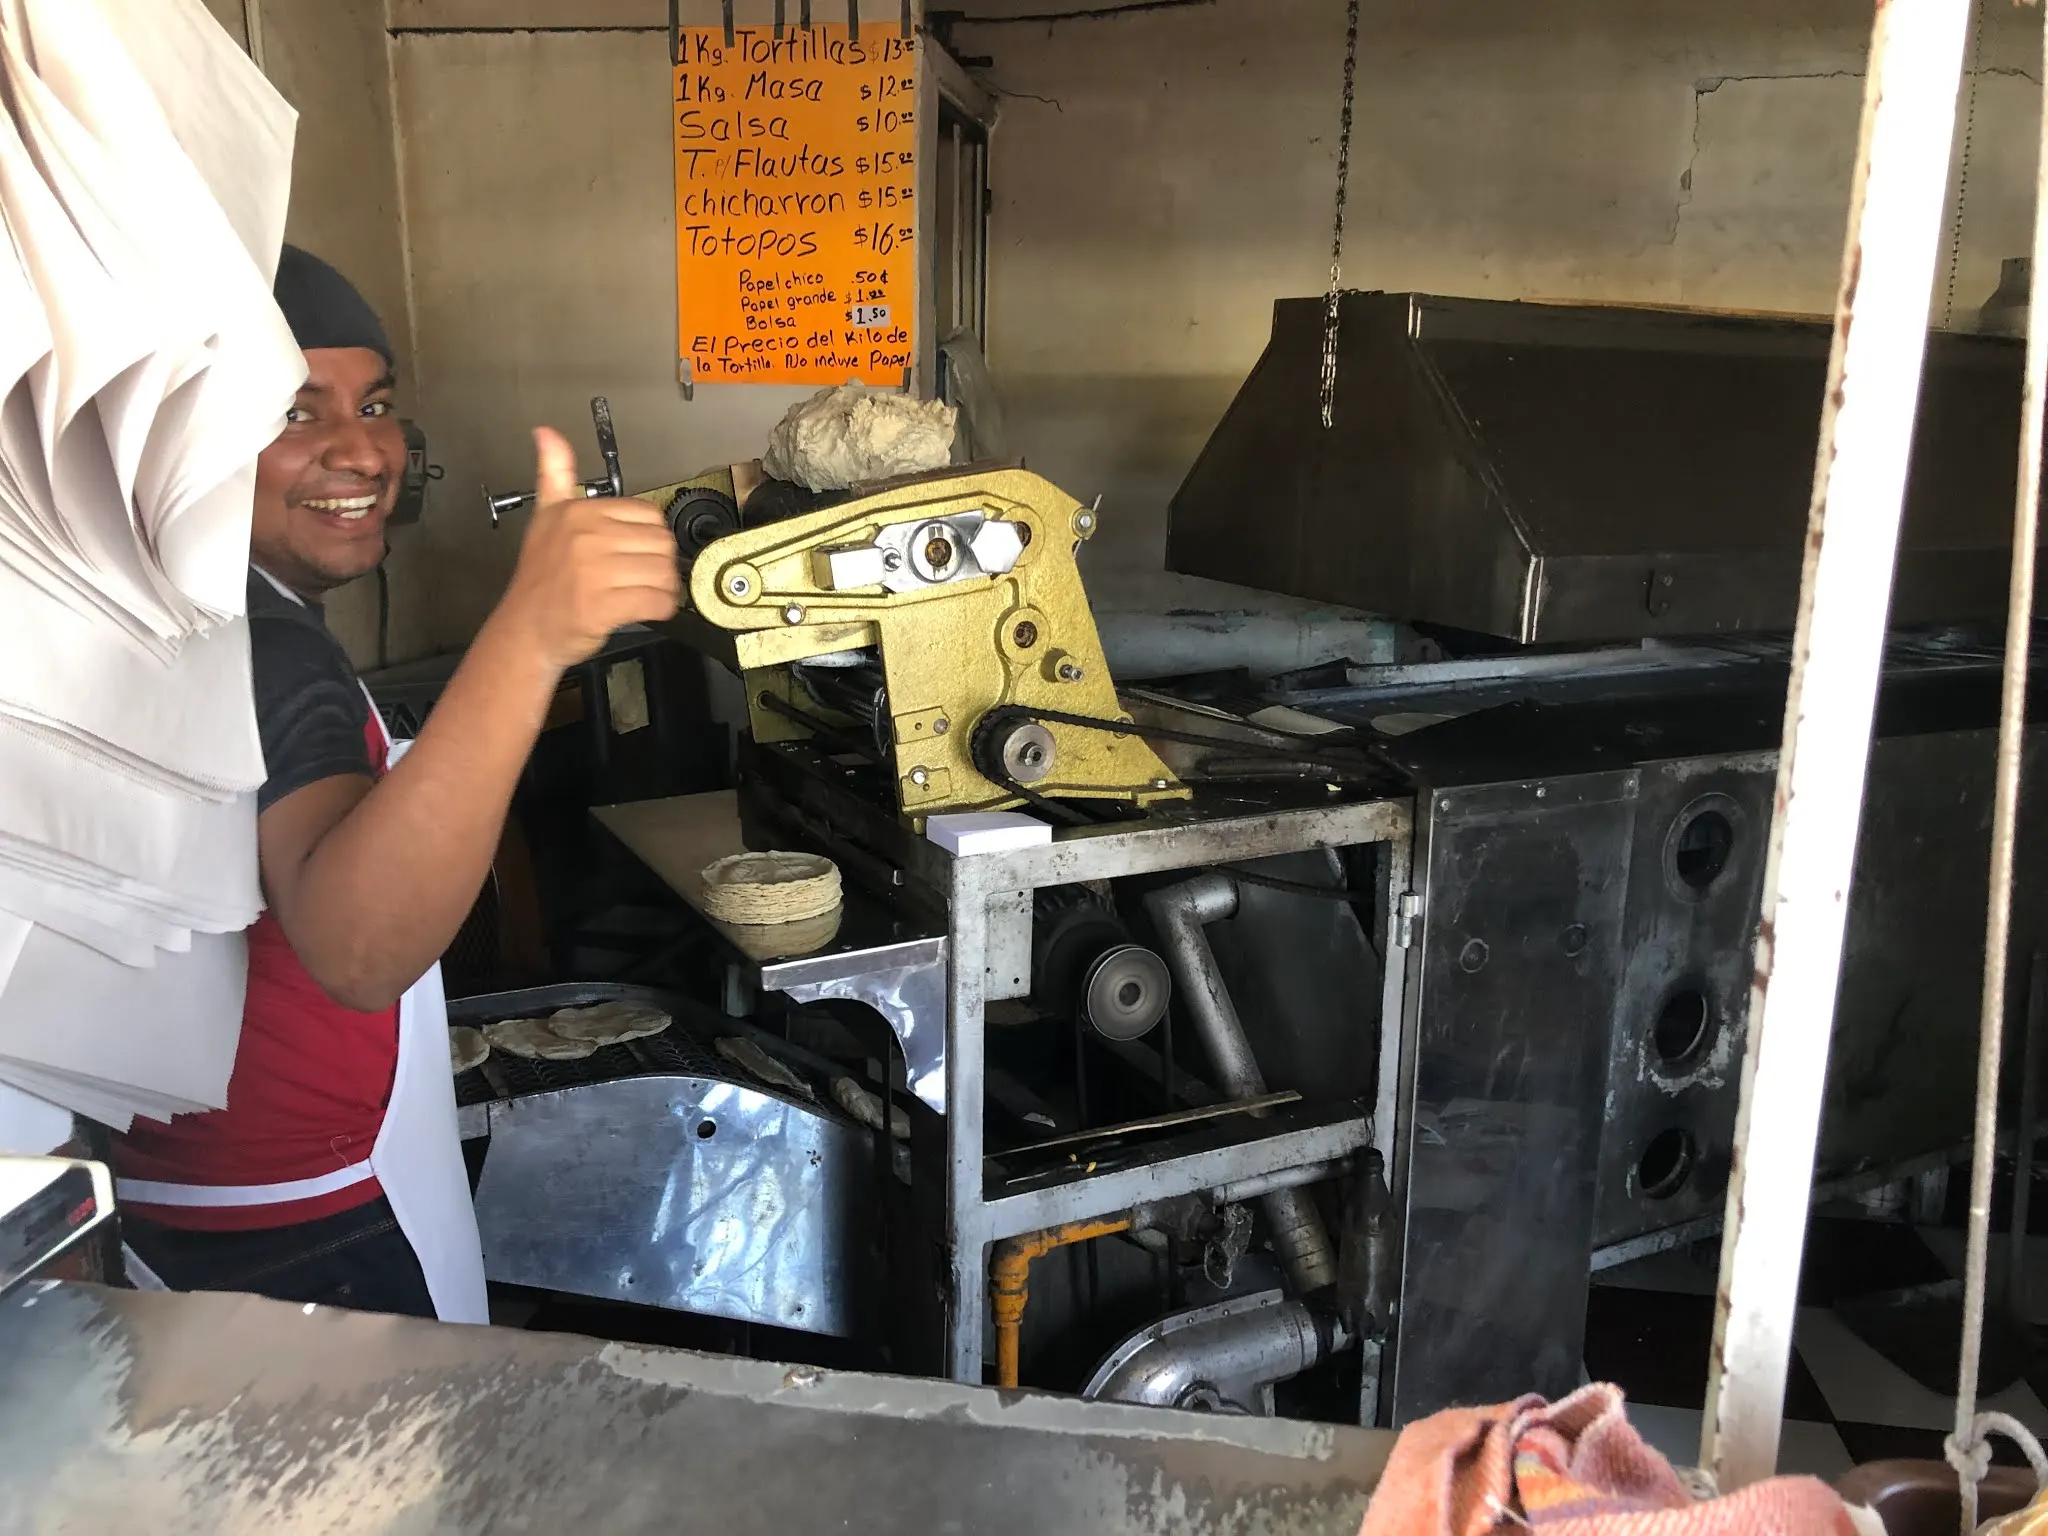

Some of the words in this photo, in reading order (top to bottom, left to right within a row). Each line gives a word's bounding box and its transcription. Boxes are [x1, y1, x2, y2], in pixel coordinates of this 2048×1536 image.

[736, 27, 867, 65] Tortillas
[744, 70, 823, 102] Masa
[680, 110, 789, 141] Salsa
[734, 144, 844, 180] Flautas
[686, 226, 817, 260] Totopos
[740, 269, 780, 296] Papel
[785, 270, 824, 290] chico
[741, 296, 780, 312] Papel
[787, 287, 837, 310] grande
[746, 315, 796, 330] Bolsa
[692, 335, 716, 354] El
[724, 335, 799, 356] Precio
[807, 329, 834, 348] del
[887, 325, 908, 343] de
[696, 356, 711, 373] la
[785, 353, 807, 369] No
[870, 349, 911, 372] Papel
